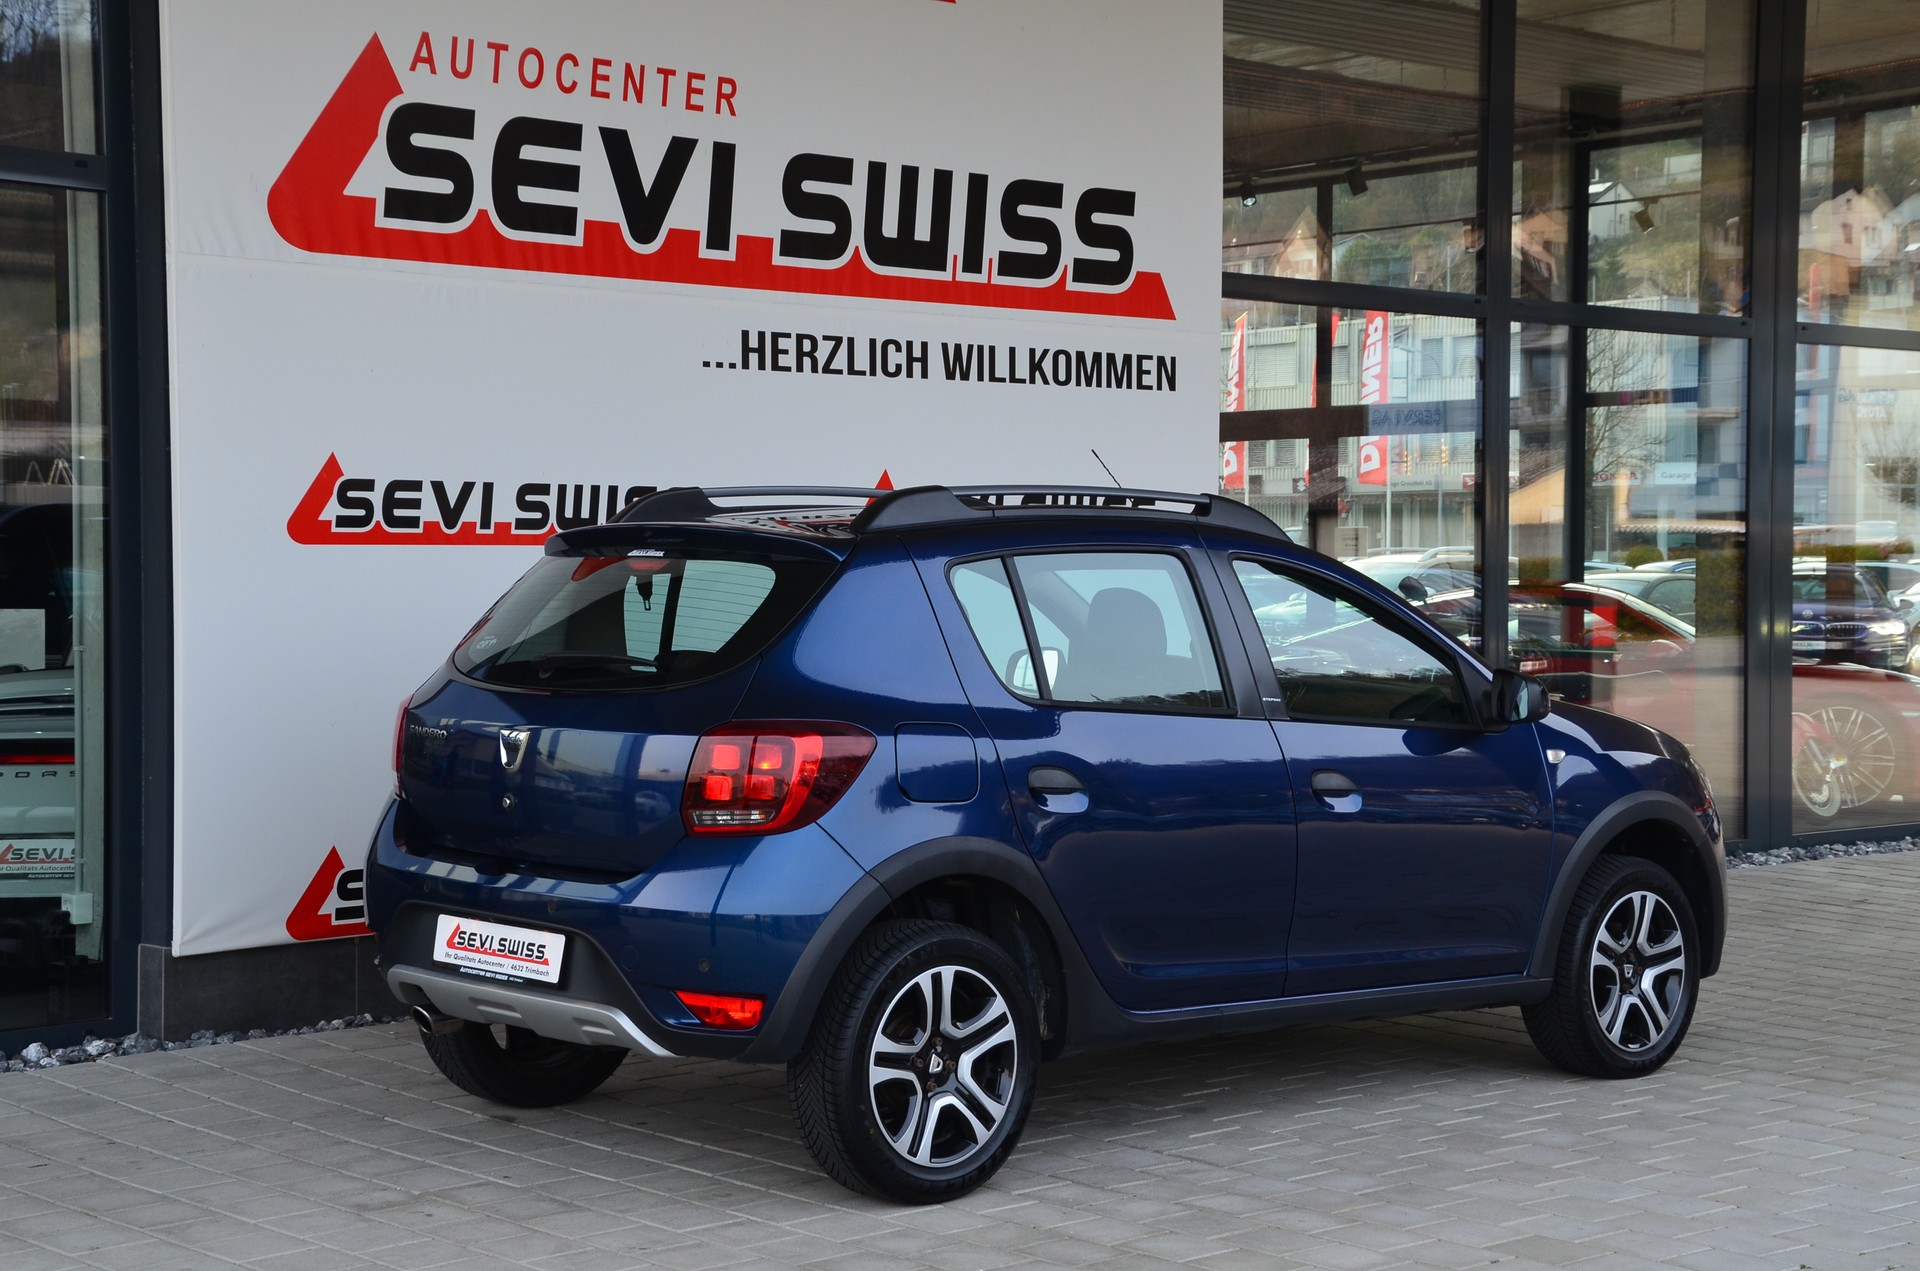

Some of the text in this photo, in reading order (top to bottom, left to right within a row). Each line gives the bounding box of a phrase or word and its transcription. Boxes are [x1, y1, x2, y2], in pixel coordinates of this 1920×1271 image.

[410, 32, 736, 114] AUTOCENTER
[384, 103, 1135, 285] SEVI SWISS
[703, 330, 1176, 391] ...HERZLICH WILLKOMMEN
[335, 479, 657, 531] SEVI SWI
[410, 725, 447, 739] SANDERO
[10, 848, 64, 860] SEVI
[444, 951, 452, 959] Ihr
[477, 958, 506, 969] Autocenter
[510, 964, 524, 973] 4632
[525, 967, 550, 977] Trimbach
[457, 930, 546, 960] SEVI SWISS
